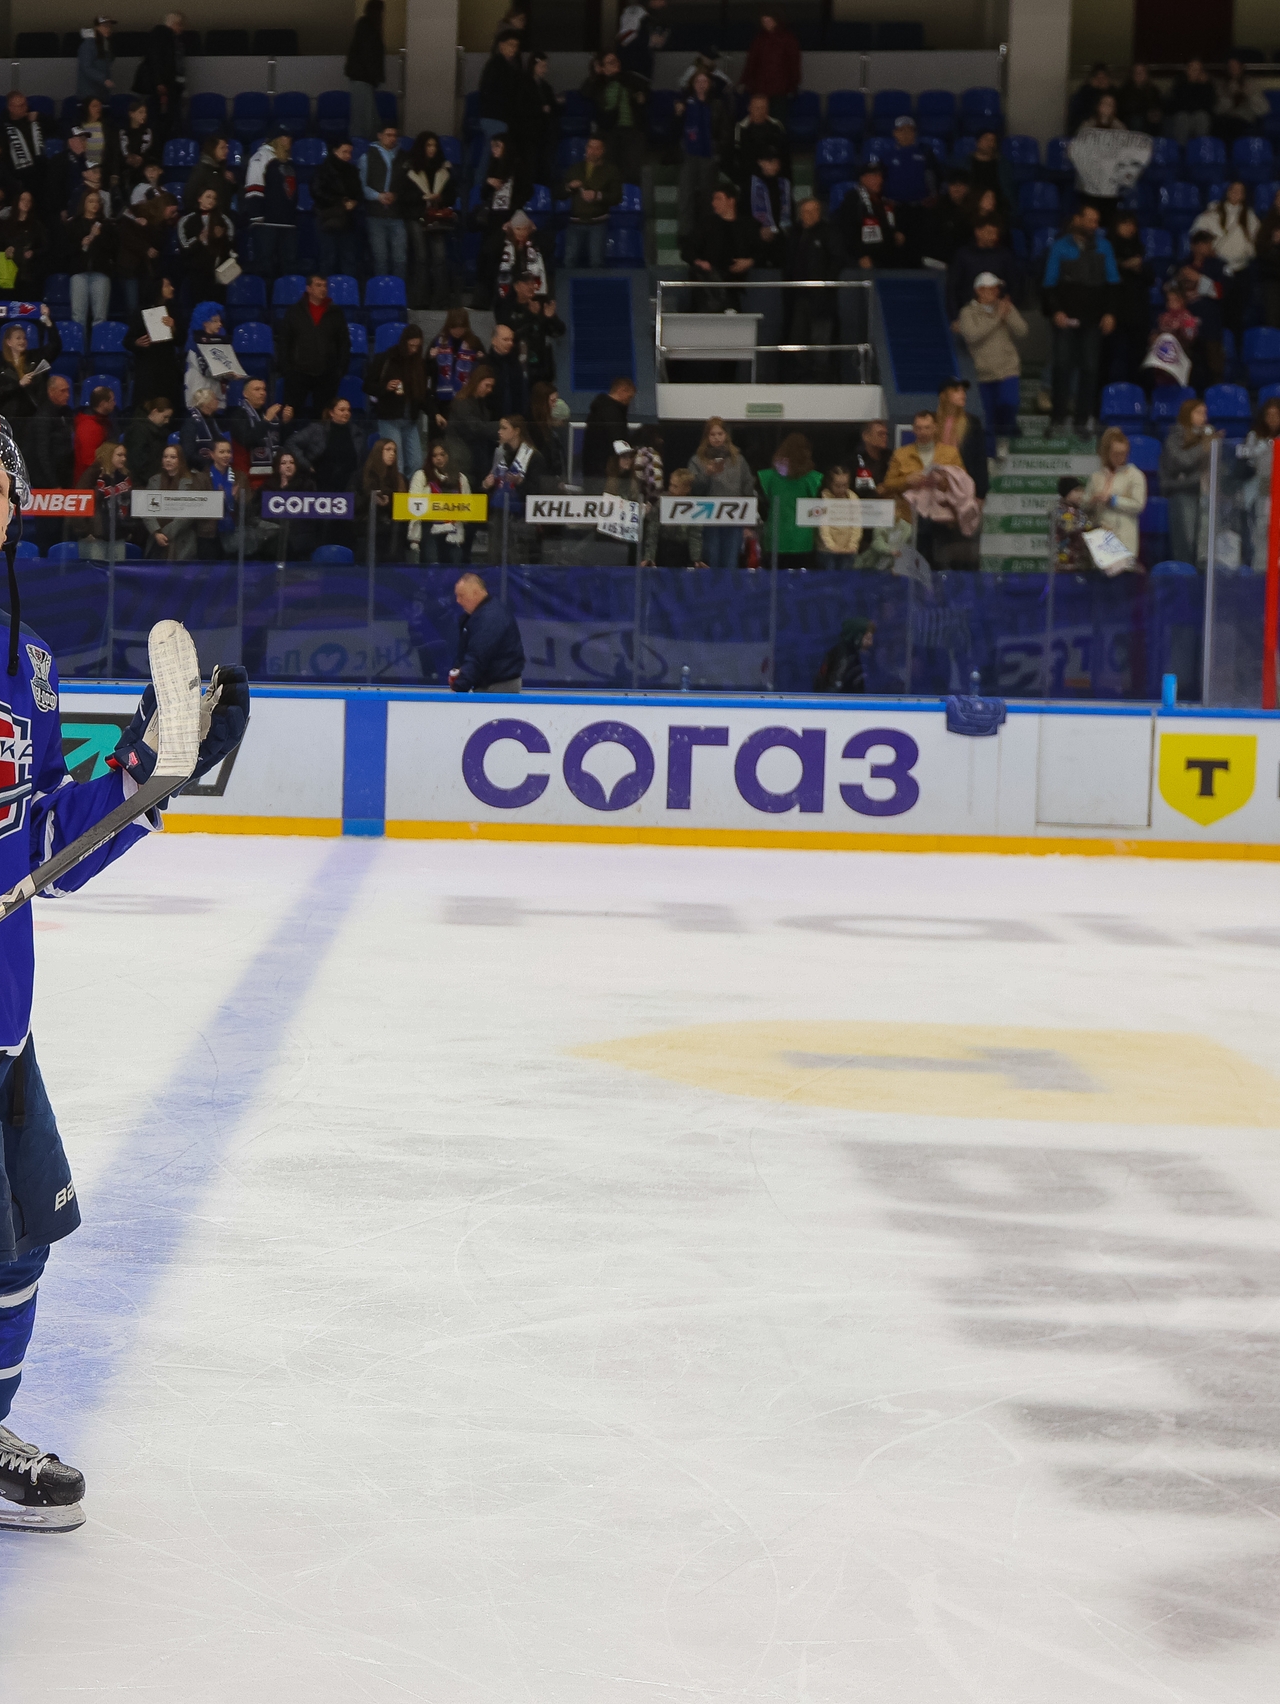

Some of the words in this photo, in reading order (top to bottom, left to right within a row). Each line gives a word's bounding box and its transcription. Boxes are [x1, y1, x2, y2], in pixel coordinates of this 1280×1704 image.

[20, 494, 93, 511] ONBET
[431, 503, 471, 512] БАНК
[532, 501, 614, 517] KHL.RU
[668, 502, 748, 519] PARI
